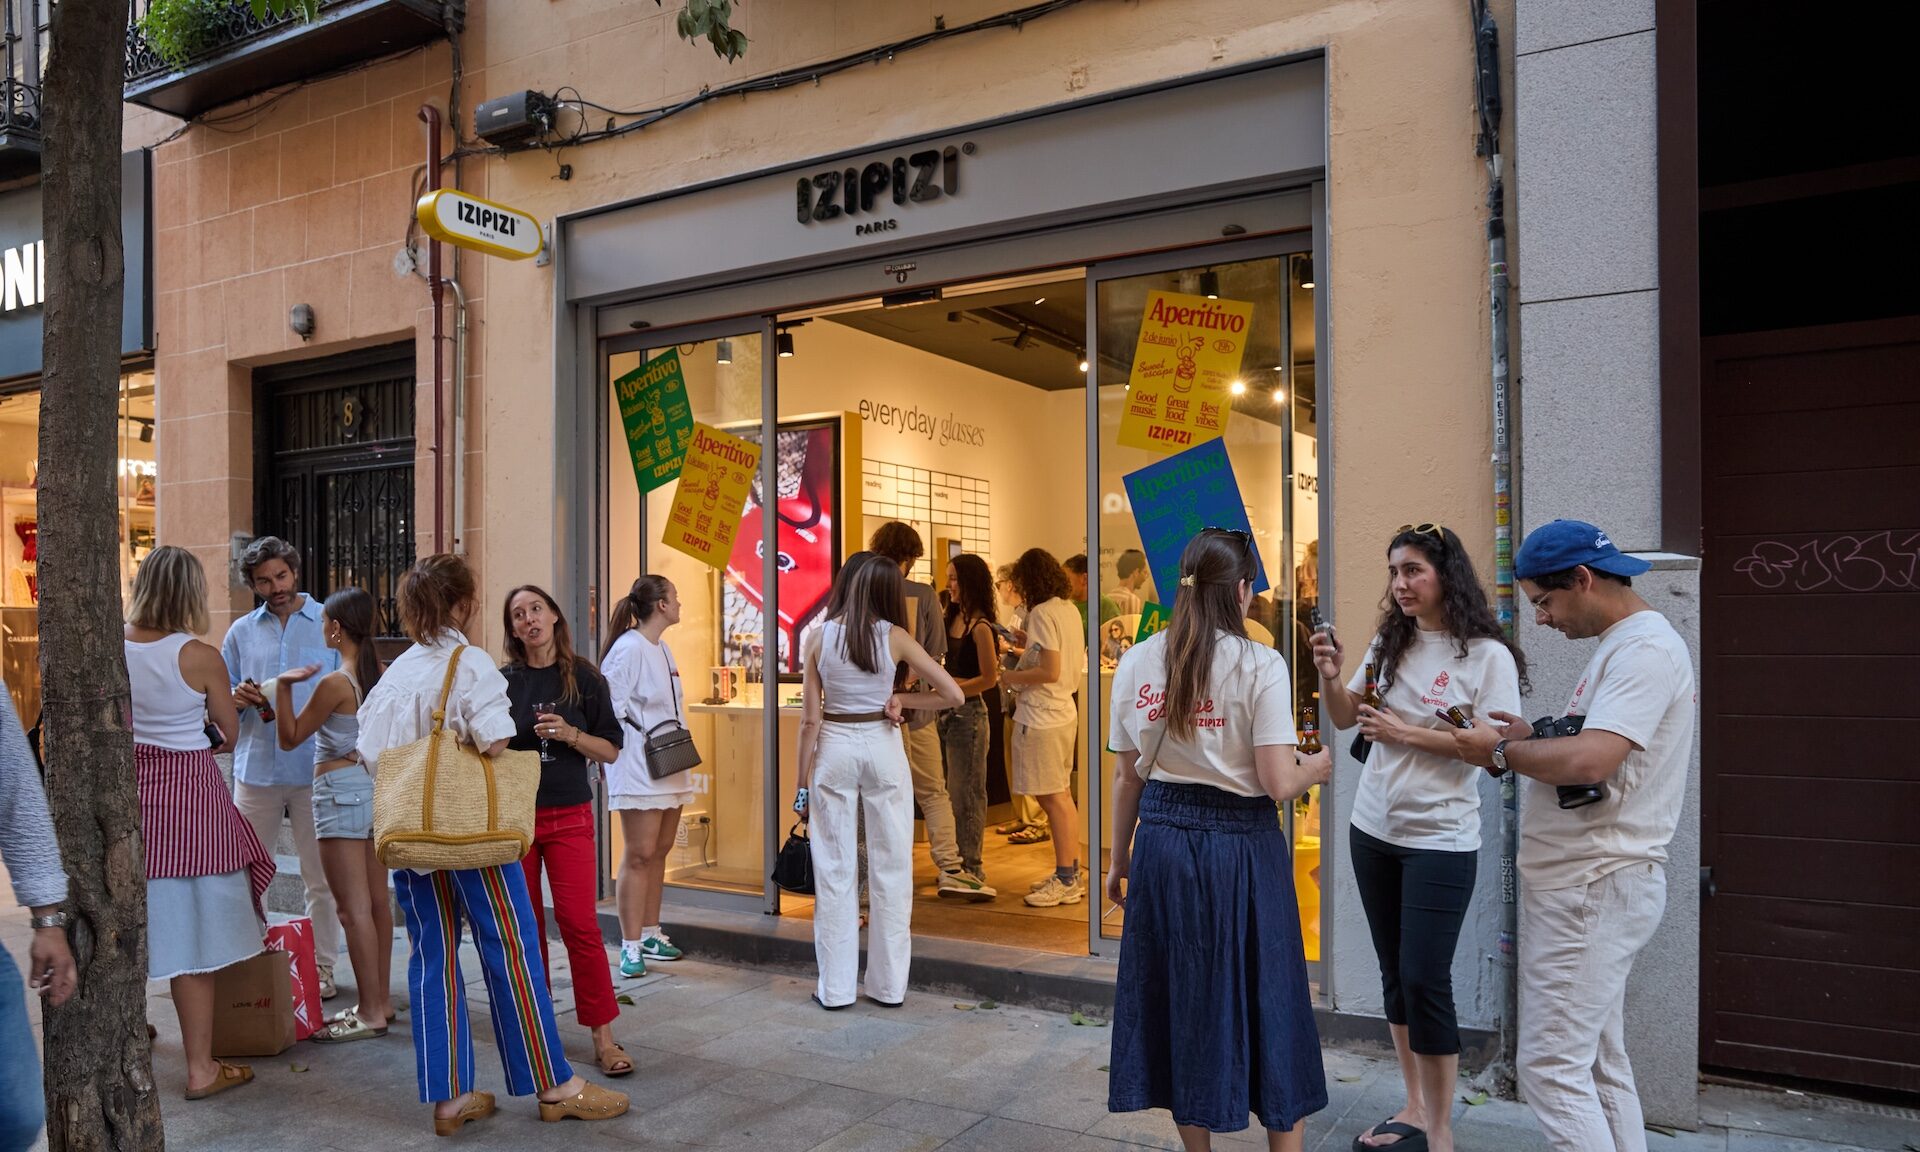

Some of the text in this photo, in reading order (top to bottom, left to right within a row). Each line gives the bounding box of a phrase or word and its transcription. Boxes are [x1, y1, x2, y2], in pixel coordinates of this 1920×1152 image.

[458, 201, 515, 236] IZIPIZI
[855, 219, 897, 236] PARIS
[479, 231, 495, 240] PARIS
[1149, 298, 1244, 333] Aperitivo
[1138, 359, 1165, 372] Sweet
[1143, 367, 1174, 379] escape
[620, 358, 678, 400] Aperitivo
[1135, 390, 1158, 403] Good
[1167, 395, 1190, 409] Great
[344, 402, 353, 427] 8
[1200, 401, 1219, 414] Best
[859, 399, 985, 447] everyday glasses
[1148, 425, 1192, 444] IZIPIZI
[693, 429, 755, 469] Aperitivo
[653, 456, 682, 478] IZIPIZI
[1132, 450, 1225, 502] Aperitivo
[682, 532, 711, 553] IZIPIZI
